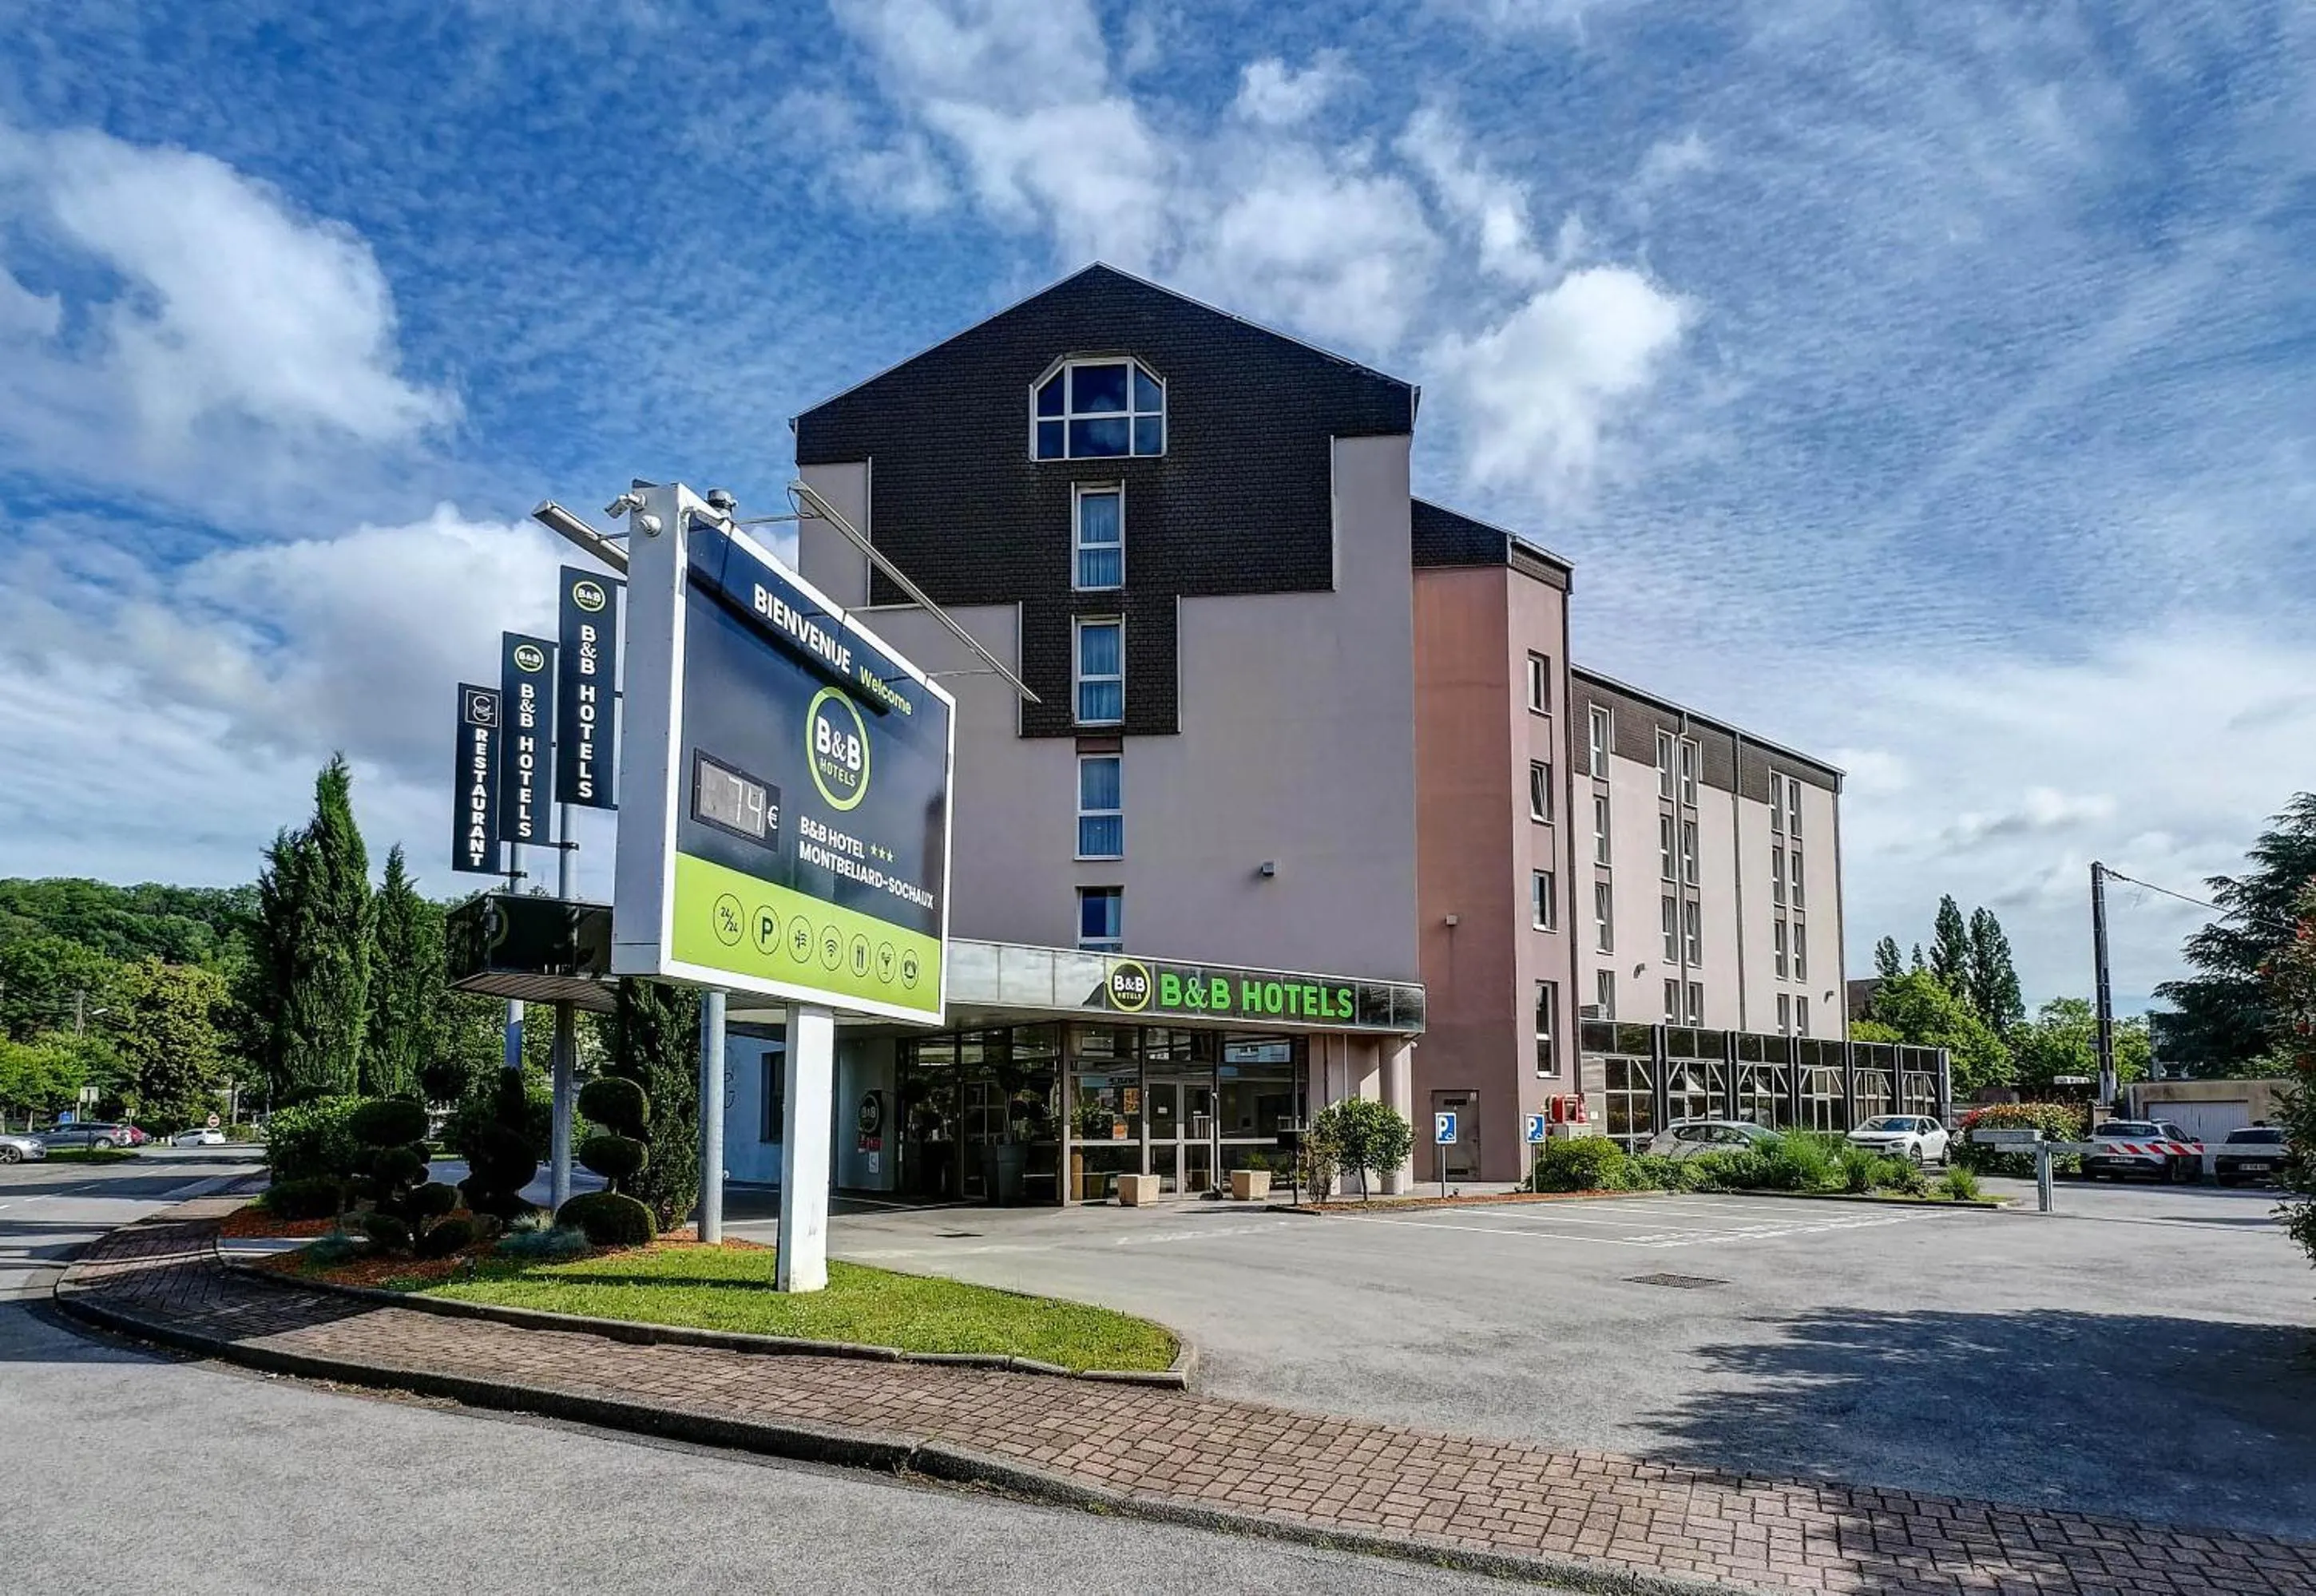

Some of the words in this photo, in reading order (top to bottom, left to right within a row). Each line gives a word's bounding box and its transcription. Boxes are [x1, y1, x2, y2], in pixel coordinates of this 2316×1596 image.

[577, 588, 601, 603] B&B
[580, 624, 597, 675] B&B
[754, 583, 851, 675] BIENVENUE
[859, 664, 912, 716] Welcome
[520, 683, 536, 727] B&B
[578, 684, 596, 798] HOTELS
[816, 715, 861, 771] B&B
[518, 735, 533, 837] HOTELS
[819, 757, 856, 787] HOTELS
[470, 728, 489, 866] RESTAURANT
[800, 816, 827, 843] B&B
[828, 829, 865, 859] HOTEL
[799, 841, 934, 909] MONTBELIARD-SOCHAUX
[761, 916, 773, 944] P
[1114, 975, 1145, 992] B&B
[1160, 973, 1231, 1009] B&B
[1243, 980, 1354, 1018] HOTELS
[1438, 1116, 1449, 1140] P
[1528, 1117, 1537, 1140] P
